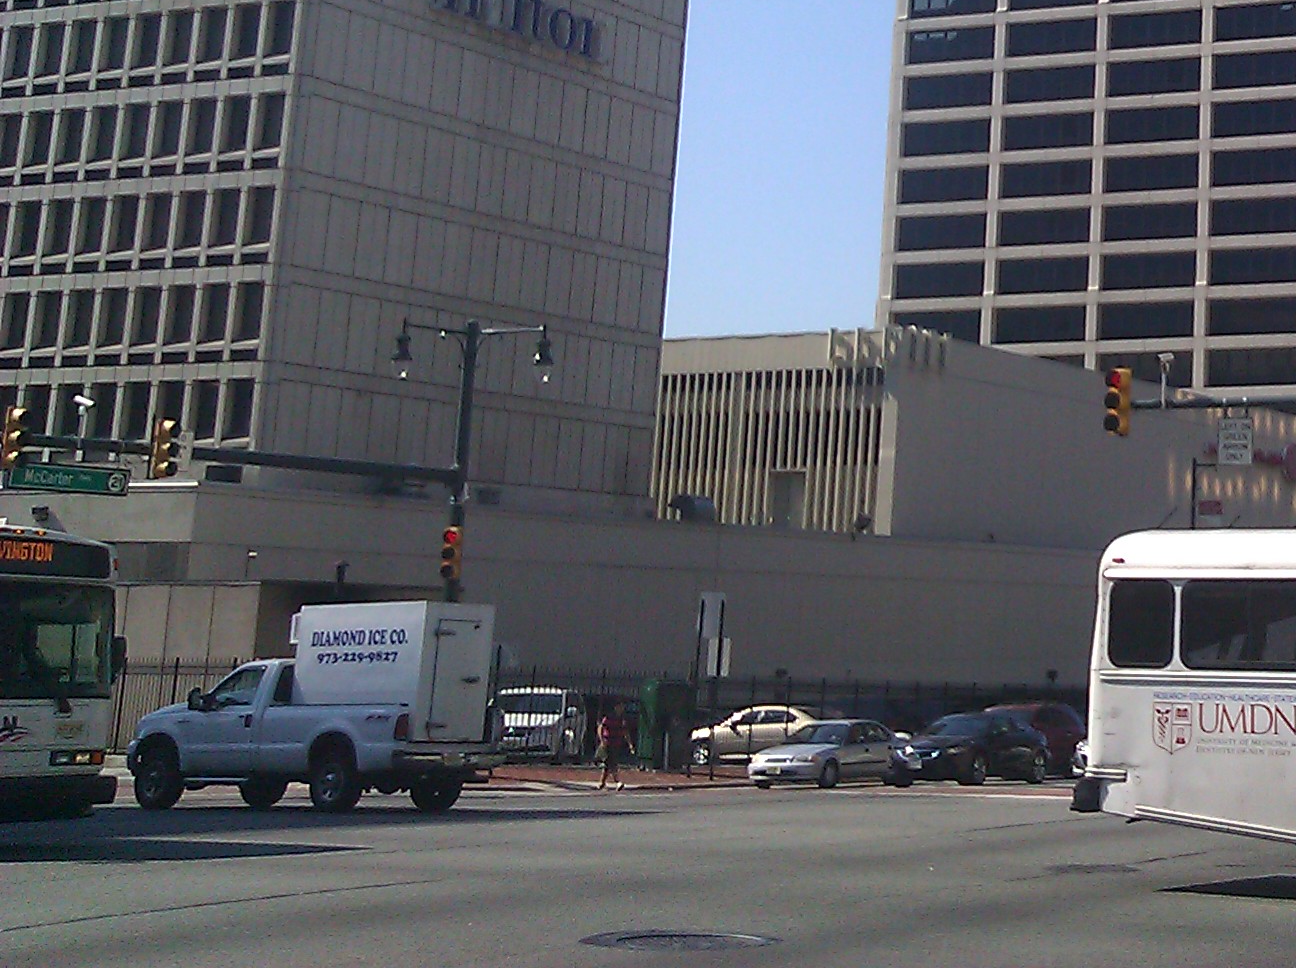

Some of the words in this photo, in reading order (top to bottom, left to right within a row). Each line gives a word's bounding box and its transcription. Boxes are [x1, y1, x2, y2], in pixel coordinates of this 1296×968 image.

[24, 468, 73, 486] McCarter
[311, 629, 366, 647] DIAMOND
[368, 629, 388, 646] ICE
[390, 628, 408, 645] CO.
[317, 651, 398, 664] 973-229-9827
